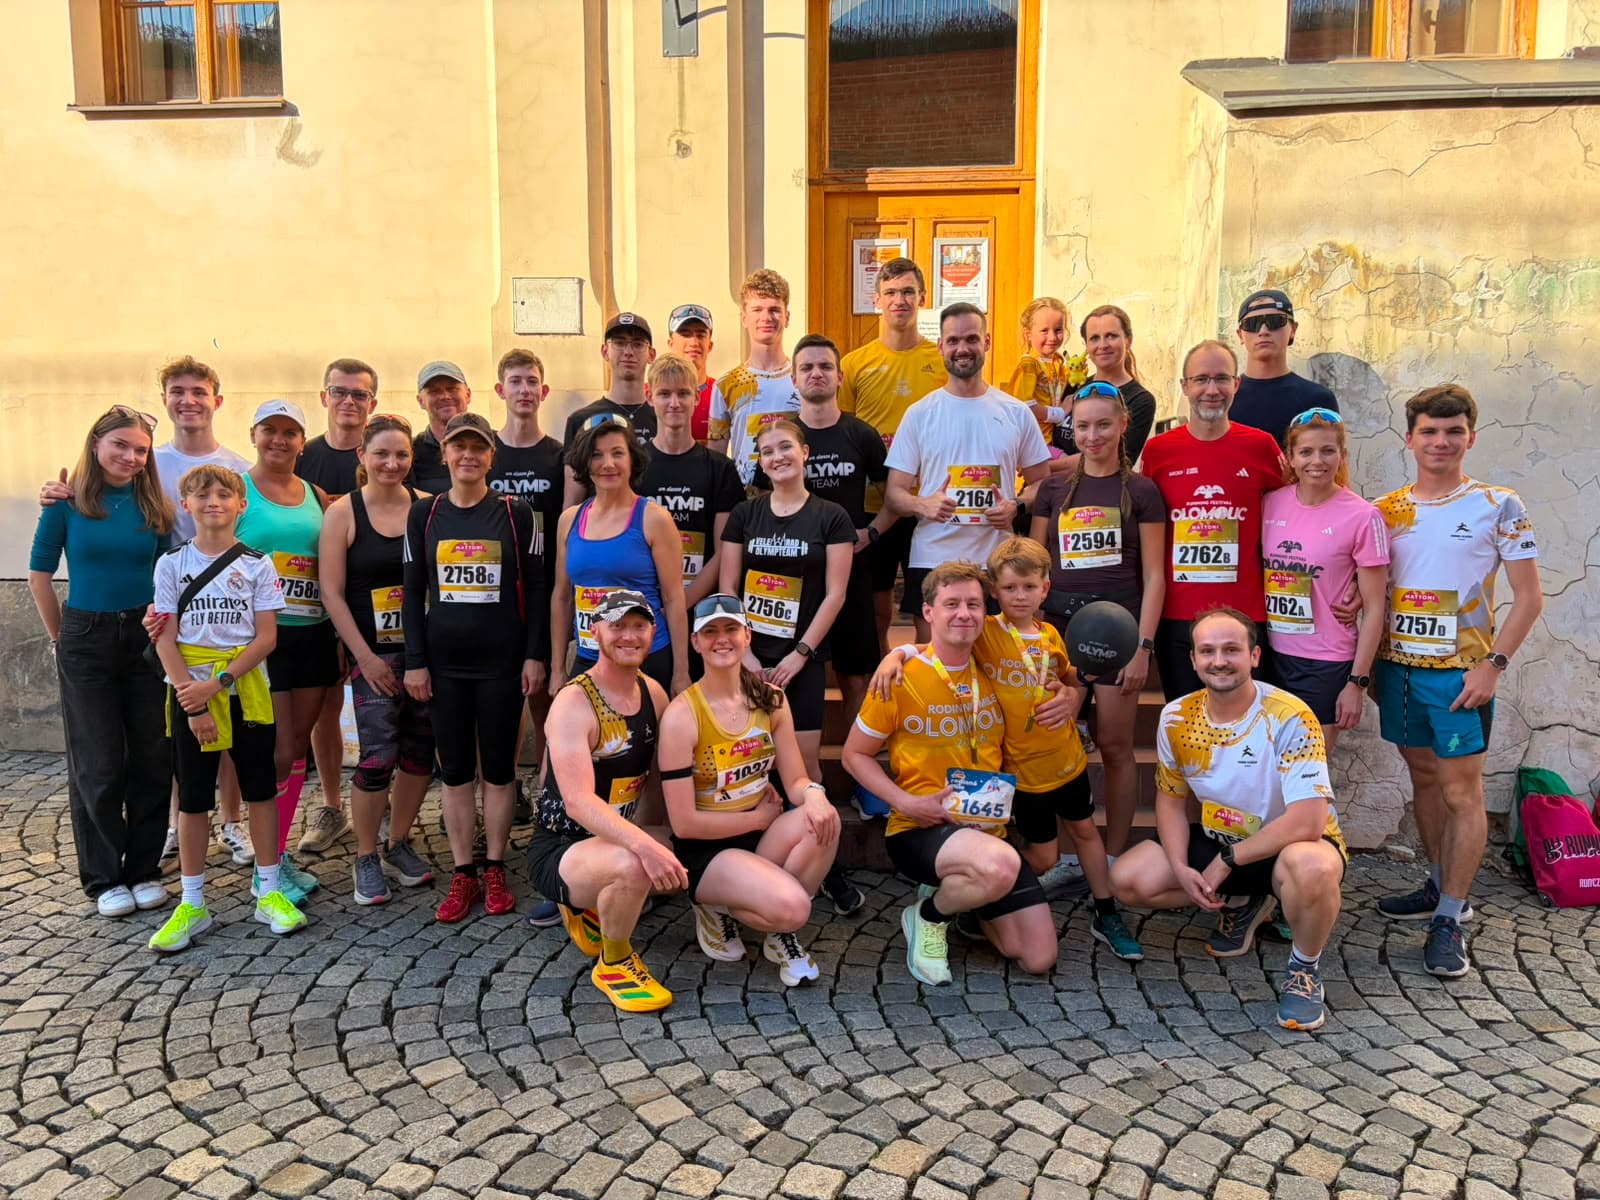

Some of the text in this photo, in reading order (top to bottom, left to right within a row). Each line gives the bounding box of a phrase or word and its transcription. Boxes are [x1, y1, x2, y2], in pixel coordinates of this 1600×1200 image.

[963, 469, 991, 477] MATTONI
[490, 478, 552, 493] OLYMP
[811, 478, 840, 489] TEAM
[956, 489, 994, 508] 2164
[673, 512, 690, 522] AM
[1075, 510, 1102, 518] MATTONI
[1171, 506, 1248, 522] OLOMOUC
[1063, 531, 1117, 553] F2594
[455, 544, 484, 552] MATTONI
[759, 576, 786, 586] MATTONI
[1271, 575, 1296, 583] MATTONI
[1404, 594, 1435, 602] MATTONI
[191, 611, 242, 626] FLY BETTER
[381, 610, 401, 630] 27
[1078, 642, 1118, 660] OLYMP
[732, 741, 761, 752] MATTONI
[949, 795, 1005, 818] 21645
[1216, 811, 1243, 823] MATTONI
